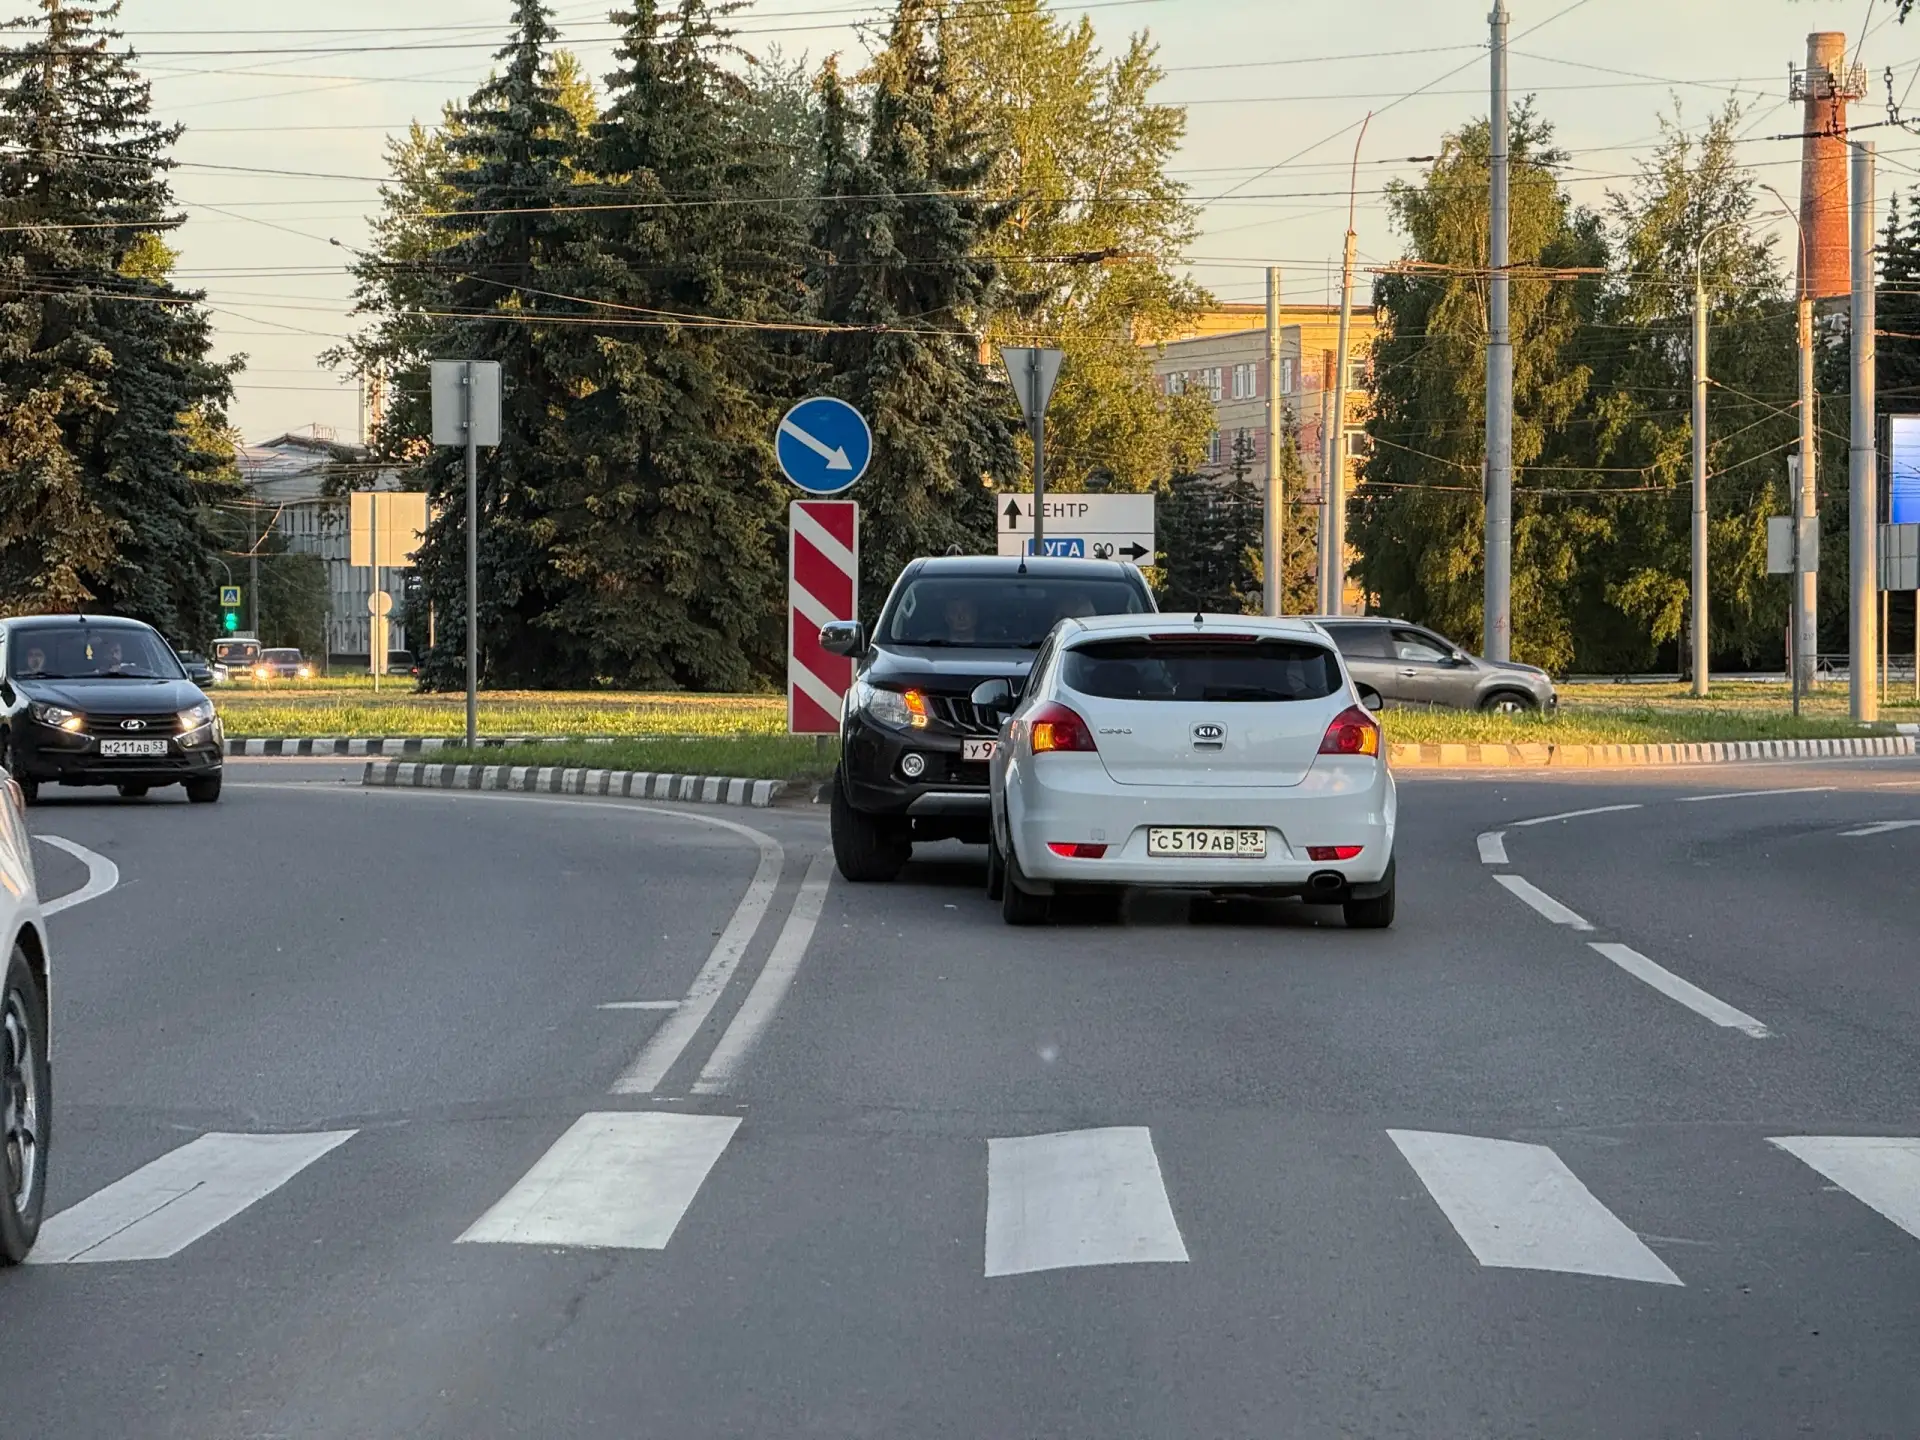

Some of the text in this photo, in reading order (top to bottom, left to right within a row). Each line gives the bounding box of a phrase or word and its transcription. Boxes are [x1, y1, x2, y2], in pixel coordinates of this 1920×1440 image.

[1031, 542, 1114, 557] УГА 90
[1199, 728, 1218, 736] KIA
[1157, 832, 1258, 850] С519АВ 53
